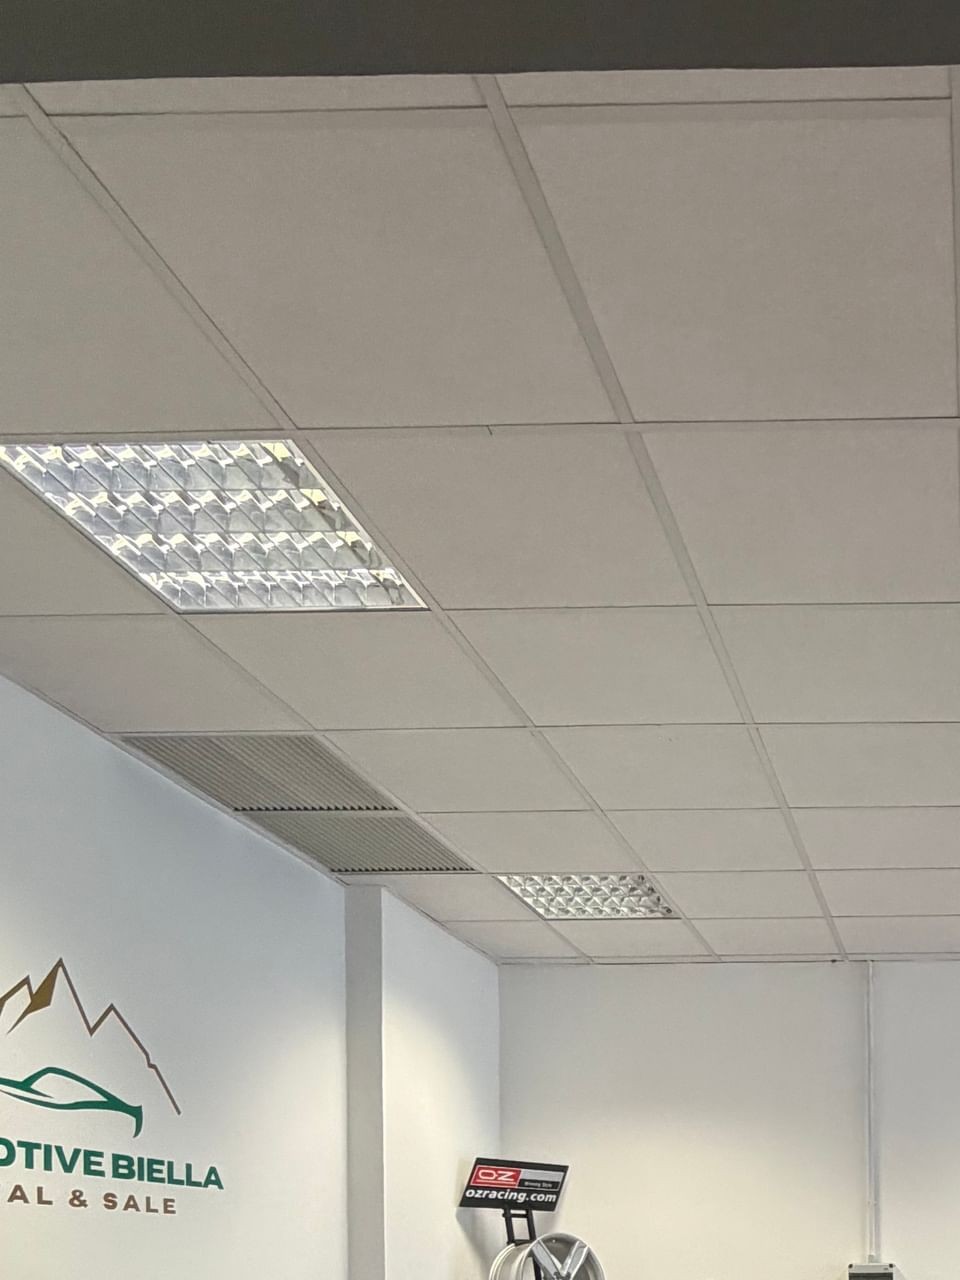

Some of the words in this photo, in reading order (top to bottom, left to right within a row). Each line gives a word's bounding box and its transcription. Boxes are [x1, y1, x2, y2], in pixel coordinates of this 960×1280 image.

[111, 1153, 224, 1190] BIELLA
[478, 1169, 517, 1181] OZ
[69, 1189, 88, 1208] &
[103, 1192, 177, 1214] SALE
[465, 1189, 557, 1203] ozracing.com
